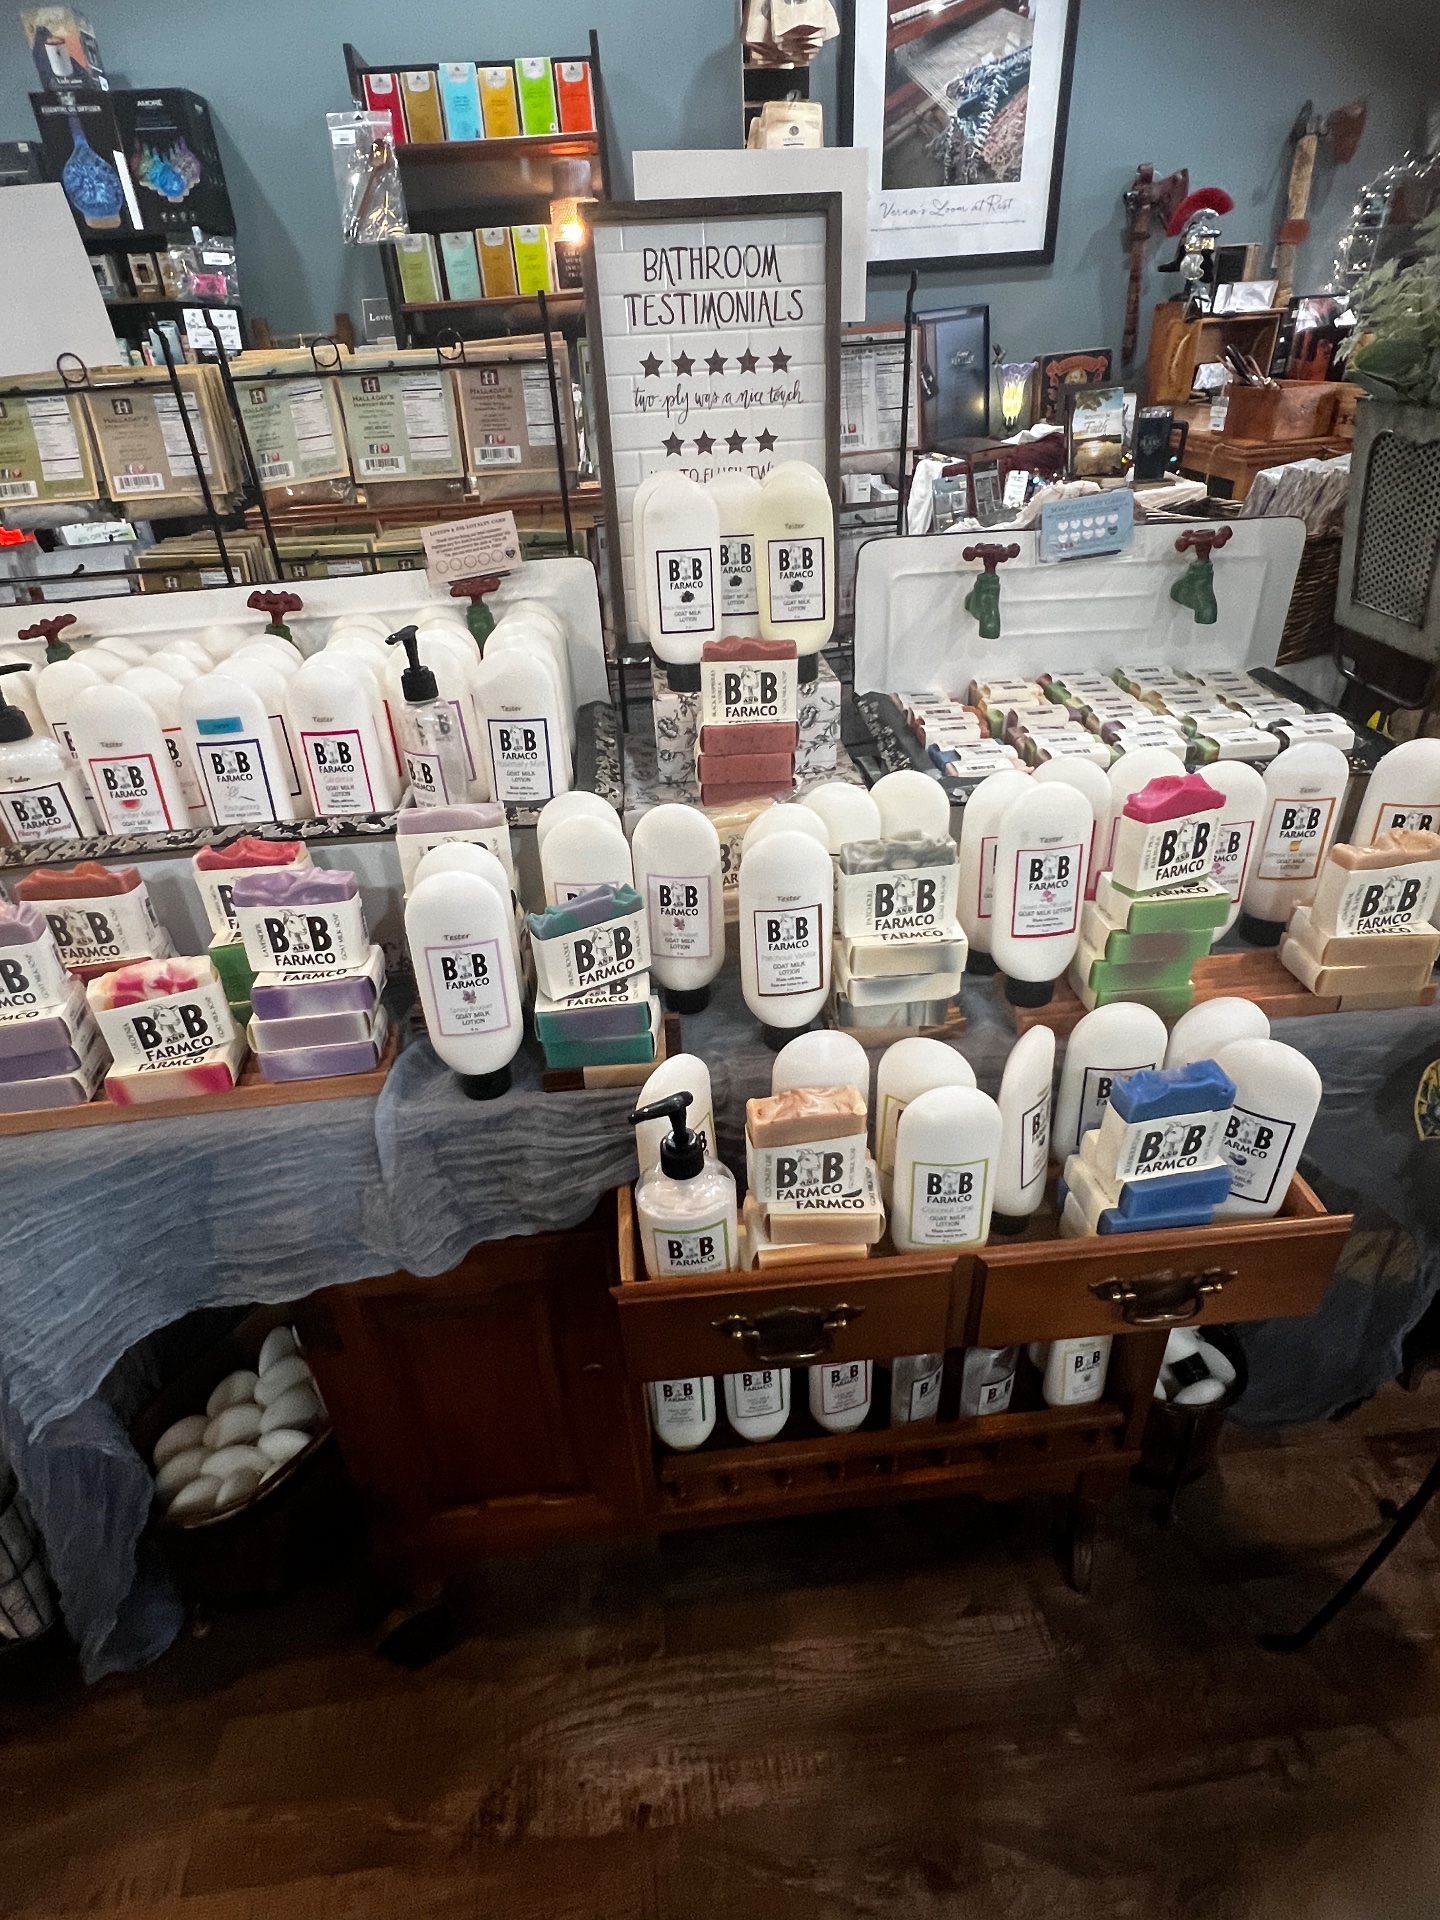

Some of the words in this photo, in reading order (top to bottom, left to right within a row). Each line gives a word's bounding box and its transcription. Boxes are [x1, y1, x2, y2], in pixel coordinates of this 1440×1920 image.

[929, 199, 968, 217] Loom
[983, 194, 1013, 213] Rest
[643, 244, 782, 286] BATHROOM
[623, 289, 804, 329] TESTIMONIALS
[353, 394, 394, 402] HALLADAY'S
[694, 392, 720, 408] was
[722, 395, 733, 406] a
[735, 390, 764, 408] nice
[767, 379, 804, 407] touch
[466, 520, 490, 529] LOYALTY
[784, 522, 805, 530] Tester
[779, 549, 790, 571] B
[802, 547, 813, 570] B
[669, 559, 680, 581] B
[692, 558, 703, 580] B
[779, 570, 814, 579] FARMCO
[670, 581, 704, 590] FARMCO
[725, 673, 741, 705] B
[761, 672, 777, 704] B
[726, 705, 777, 717] FARMCO
[500, 729, 512, 751] B
[523, 729, 536, 751] B
[502, 752, 537, 760] FARMCO
[318, 764, 354, 774] FARMCO
[102, 768, 119, 790] B
[128, 766, 144, 788] B
[217, 773, 253, 783] FARMCO
[109, 788, 148, 799] FARMCO
[21, 817, 61, 830] FARMCO
[1279, 829, 1316, 839] FARMCO
[1158, 829, 1178, 867] B
[1192, 822, 1210, 859] B
[1029, 858, 1044, 882] B
[1056, 855, 1070, 880] B
[1156, 859, 1204, 881] FARMCO
[1028, 880, 1069, 891] FARMCO
[776, 895, 801, 903] Tester
[874, 883, 895, 918] B
[895, 905, 913, 915] AND
[916, 879, 936, 913] B
[660, 907, 698, 917] FARMCO
[46, 914, 74, 946] B
[86, 911, 114, 945] B
[874, 914, 935, 931] FARMCO
[1356, 912, 1412, 931] FARMCO
[264, 918, 290, 953] B
[292, 944, 311, 952] AND
[307, 916, 332, 951] B
[443, 933, 470, 941] Tester
[767, 919, 781, 943] B
[795, 917, 808, 940] B
[881, 930, 944, 941] FARMCO
[61, 945, 120, 958] FARMCO
[574, 939, 596, 974] B
[597, 956, 614, 967] AND
[613, 926, 633, 961] B
[768, 939, 809, 951] FARMCO
[274, 953, 336, 967] FARMCO
[441, 956, 458, 981] B
[471, 953, 488, 978] B
[282, 968, 347, 982] FARMCO
[579, 959, 635, 986] FARMCO
[446, 977, 489, 990] FARMCO
[566, 994, 629, 1007] FARMCO
[455, 1012, 472, 1020] GOAT
[473, 1010, 490, 1018] MILK
[462, 1018, 486, 1026] LOTION
[131, 1016, 162, 1050] B
[166, 1033, 185, 1043] AND
[179, 1004, 208, 1038] B
[146, 1035, 214, 1061] FARMCO
[138, 1056, 205, 1072] FARMCO
[1137, 1131, 1163, 1163] B
[1180, 1124, 1206, 1156] B
[776, 1157, 798, 1189] B
[800, 1177, 819, 1187] AND
[822, 1151, 844, 1184] B
[1134, 1155, 1198, 1176] FARMCO
[776, 1183, 843, 1200] FARMCO
[927, 1172, 942, 1195] B
[958, 1172, 973, 1194] B
[796, 1198, 865, 1210] FARMCO
[926, 1194, 972, 1204] FARMCO
[670, 1254, 715, 1267] FARMCO
